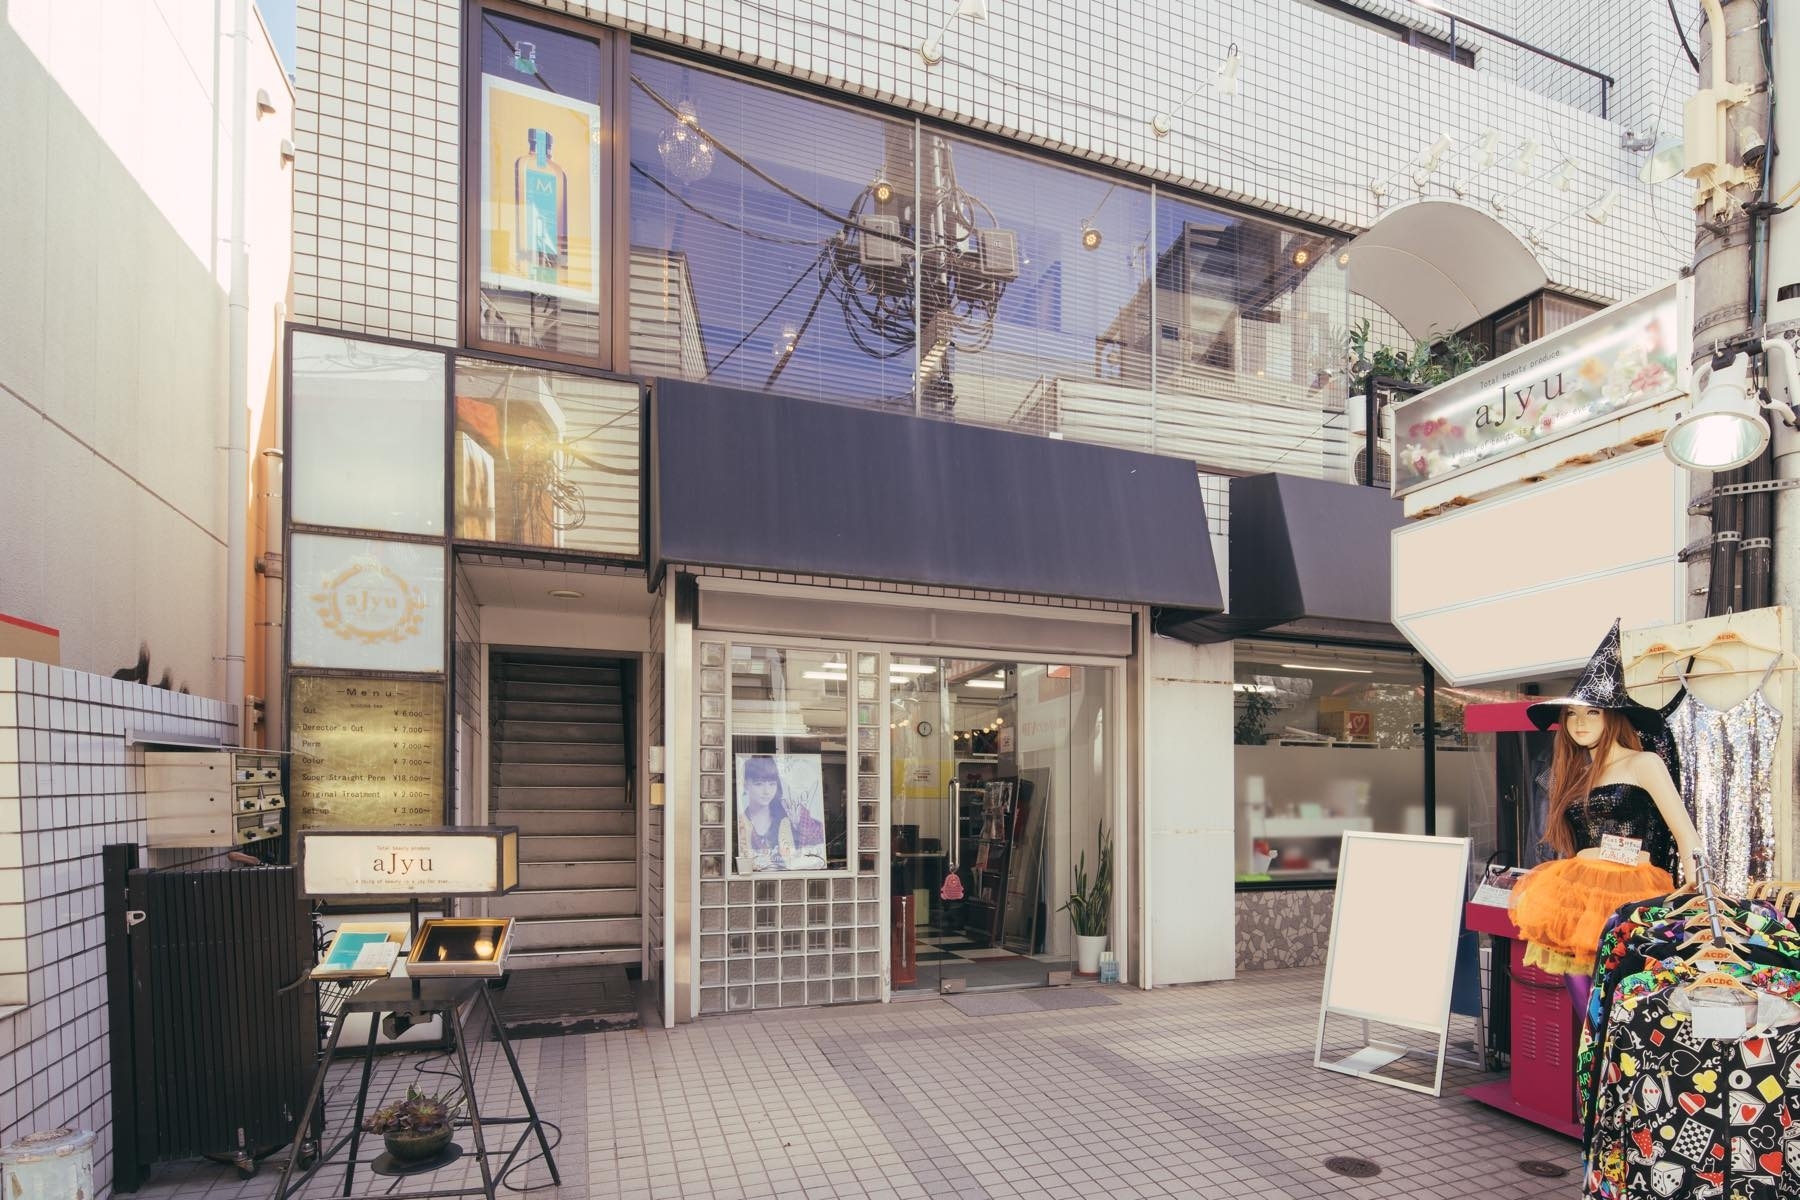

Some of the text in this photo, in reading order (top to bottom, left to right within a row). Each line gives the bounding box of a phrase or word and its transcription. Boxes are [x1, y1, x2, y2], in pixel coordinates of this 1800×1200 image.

[1480, 350, 1560, 389] Total beauty produce
[1475, 372, 1566, 428] aJyu
[303, 706, 317, 714] Cut
[351, 724, 364, 732] Cut
[302, 740, 321, 748] Perm
[302, 757, 325, 765] Color
[302, 773, 325, 781] Super
[329, 773, 363, 782] Straight
[368, 773, 386, 781] Perm
[302, 790, 337, 798] Original
[343, 790, 380, 798] Treatment
[373, 853, 432, 875] aJyu
[1706, 977, 1733, 986] ACDC
